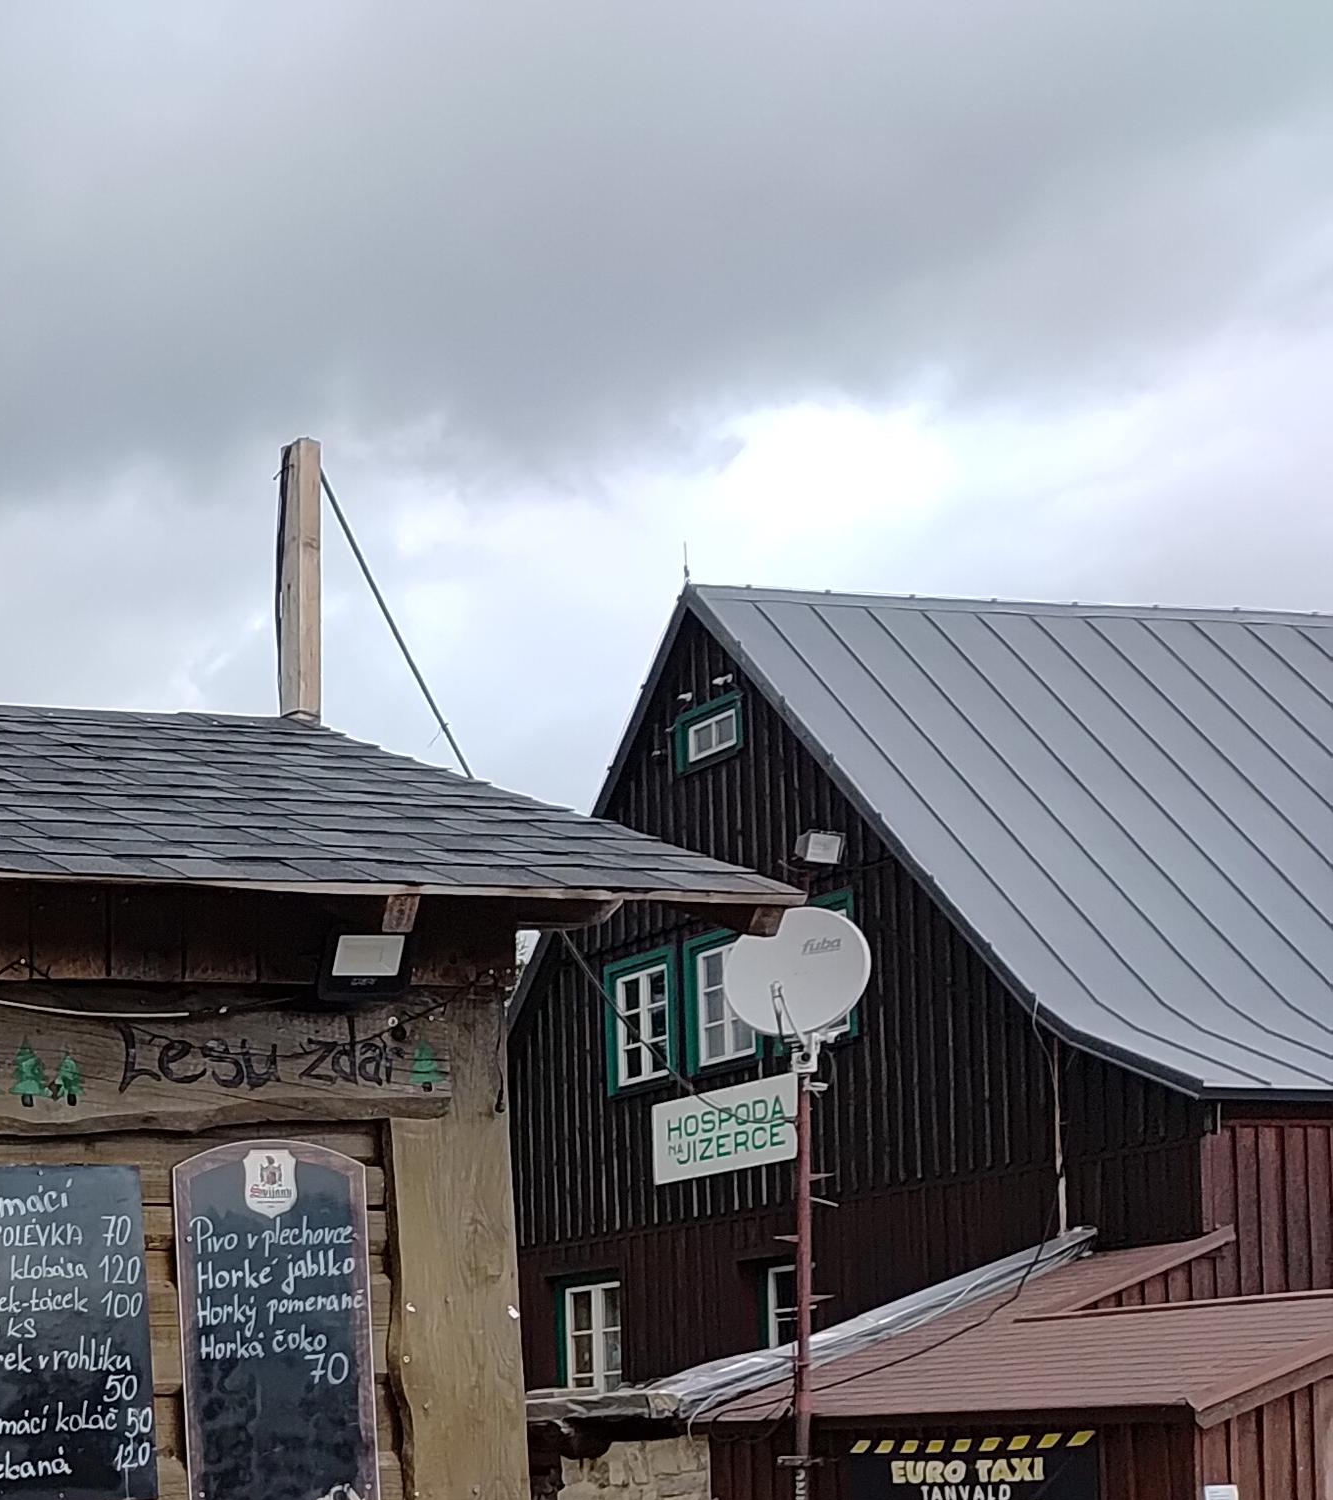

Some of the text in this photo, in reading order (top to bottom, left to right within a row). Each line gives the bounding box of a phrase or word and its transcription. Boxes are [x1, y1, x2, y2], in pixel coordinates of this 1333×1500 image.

[299, 1014, 406, 1086] zdar
[667, 1095, 785, 1141] HOSPODA
[676, 1121, 786, 1165] JIZERCE
[100, 1215, 131, 1247] 70
[189, 1215, 353, 1257] Pivo v plechovce
[10, 1254, 88, 1281] klobása
[98, 1254, 141, 1285] 120
[197, 1248, 355, 1295] Horké jablko
[100, 1289, 143, 1318] 100
[197, 1293, 257, 1338] Horký
[52, 1335, 132, 1373] rohlíku
[201, 1324, 327, 1360] Horká čoko
[304, 1352, 349, 1385] 70
[103, 1374, 138, 1402] 50
[55, 1400, 117, 1433] koláč
[126, 1406, 153, 1437] 50
[114, 1441, 151, 1472] 120
[890, 1457, 1045, 1484] EURO TAXI
